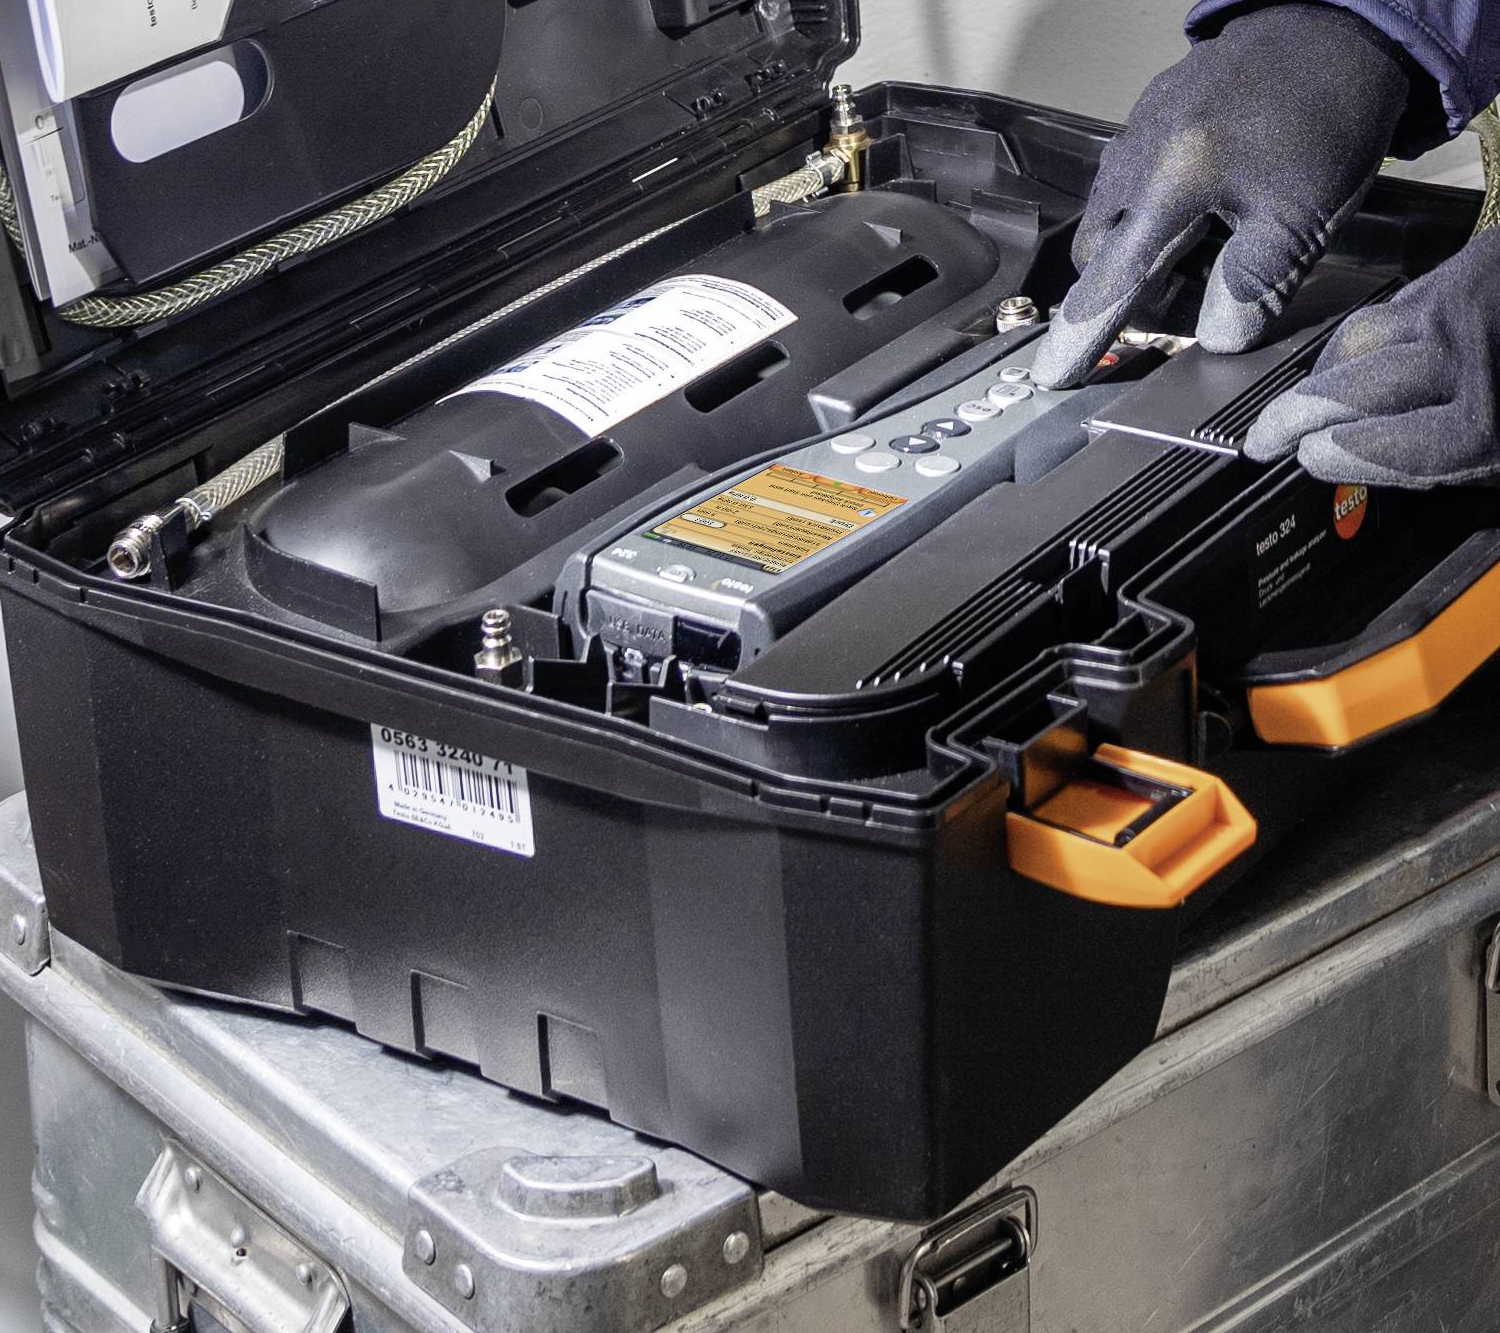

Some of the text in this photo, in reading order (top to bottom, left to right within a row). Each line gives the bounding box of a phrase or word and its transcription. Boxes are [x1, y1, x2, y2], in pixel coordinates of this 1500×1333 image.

[1334, 486, 1368, 520] testo
[1256, 514, 1296, 556] testo 324
[637, 623, 666, 641] DATA
[381, 727, 428, 753] 0563
[436, 742, 484, 767] 3240
[394, 801, 411, 810] Made
[419, 807, 447, 821] Germany
